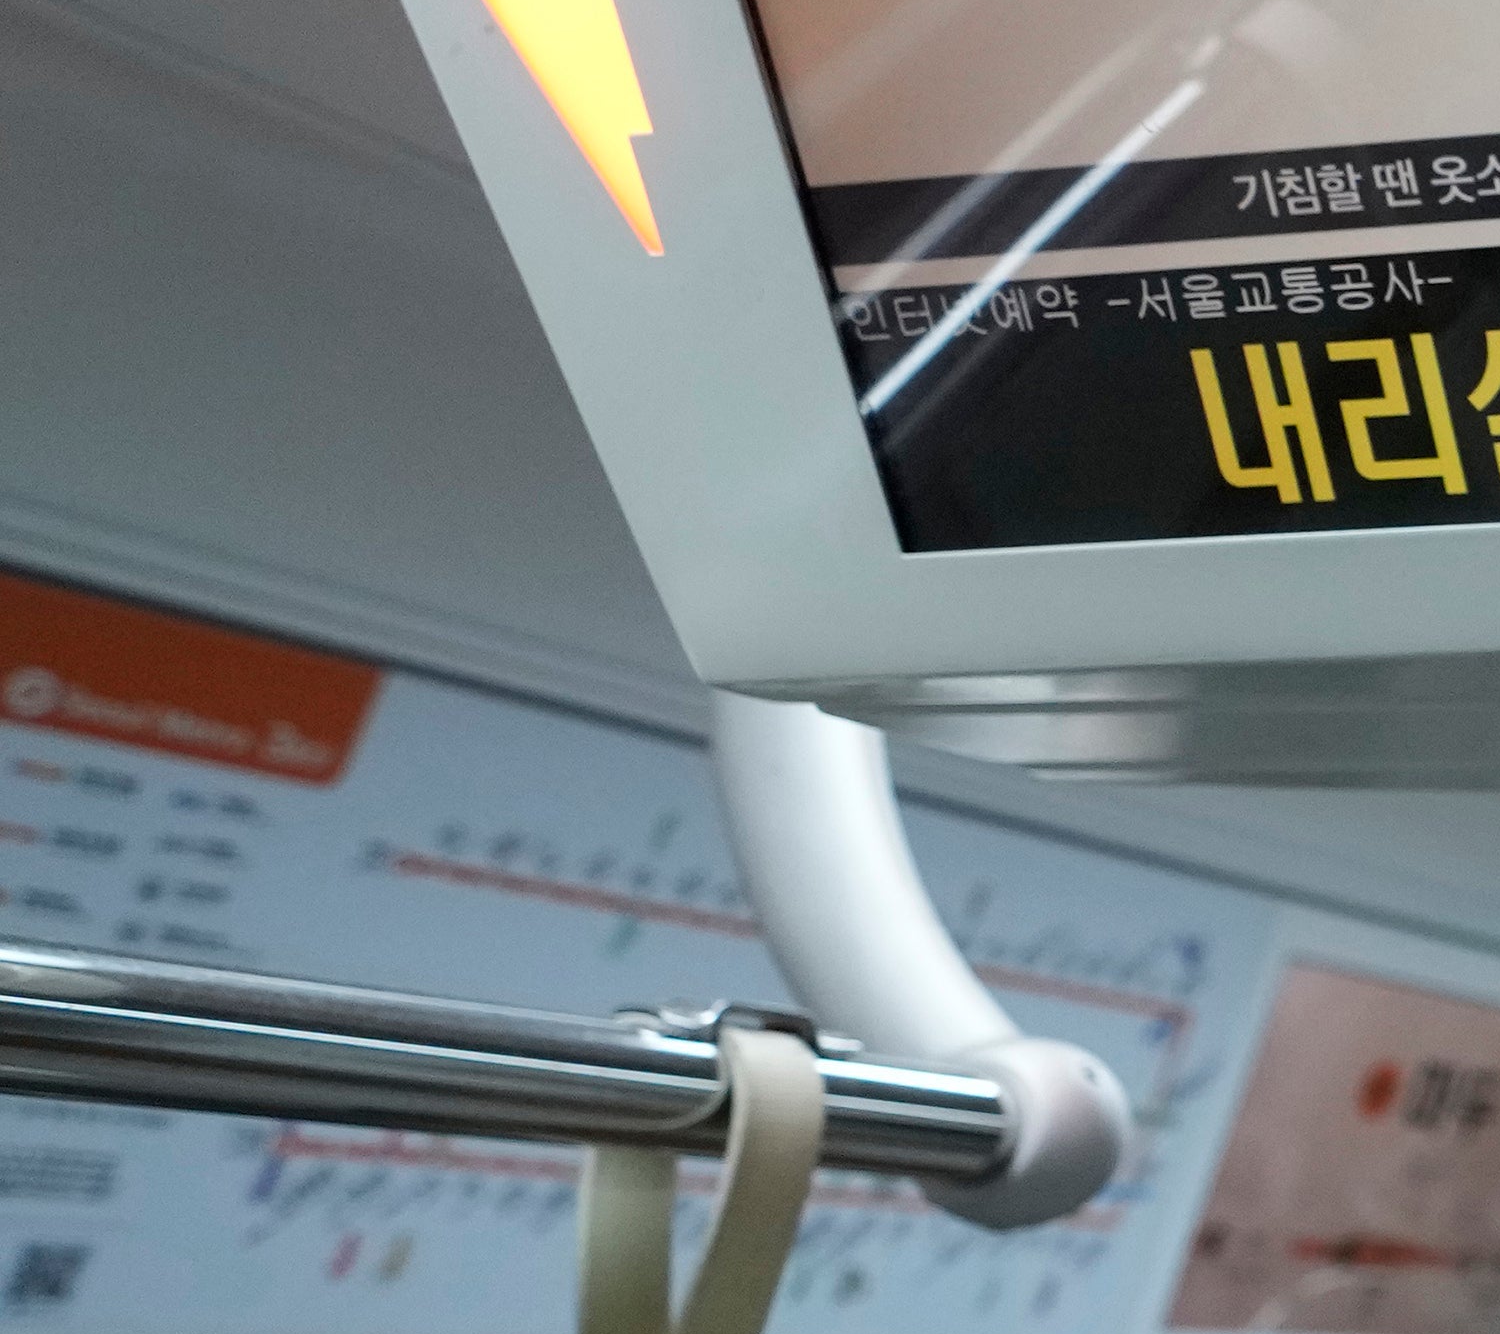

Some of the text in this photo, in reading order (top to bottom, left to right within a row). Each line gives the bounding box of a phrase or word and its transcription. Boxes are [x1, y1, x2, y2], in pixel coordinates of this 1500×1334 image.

[1233, 164, 1364, 218] 기침할
[1371, 157, 1422, 208] 땐
[1107, 260, 1453, 322] -서울교통공사-
